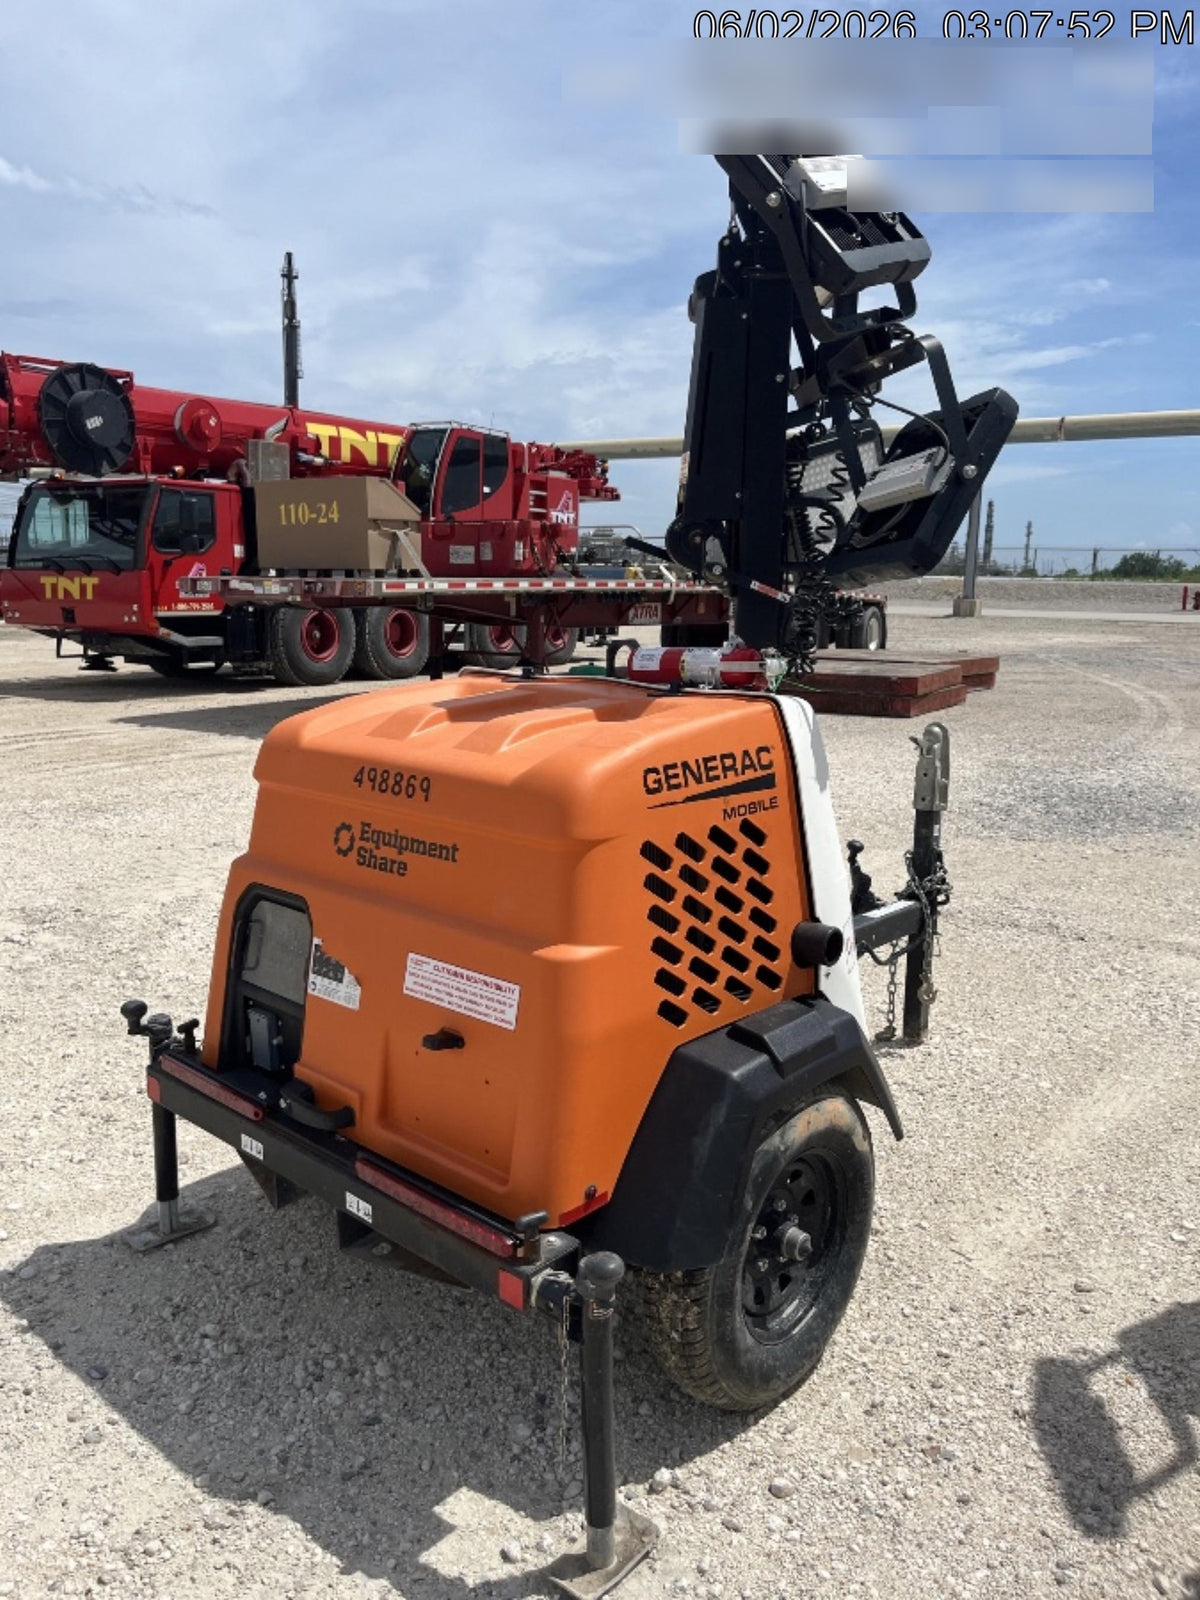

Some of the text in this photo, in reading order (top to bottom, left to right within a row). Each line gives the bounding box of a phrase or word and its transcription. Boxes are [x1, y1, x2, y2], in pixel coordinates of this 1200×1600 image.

[305, 421, 405, 468] TNT
[279, 500, 340, 526] 110-24
[550, 511, 576, 525] TNT
[40, 575, 99, 600] TNT
[353, 766, 431, 802] 498869
[643, 746, 774, 795] GENERAC
[722, 796, 779, 821] MOBILE
[359, 820, 460, 863] Equipment
[356, 845, 409, 877] Share
